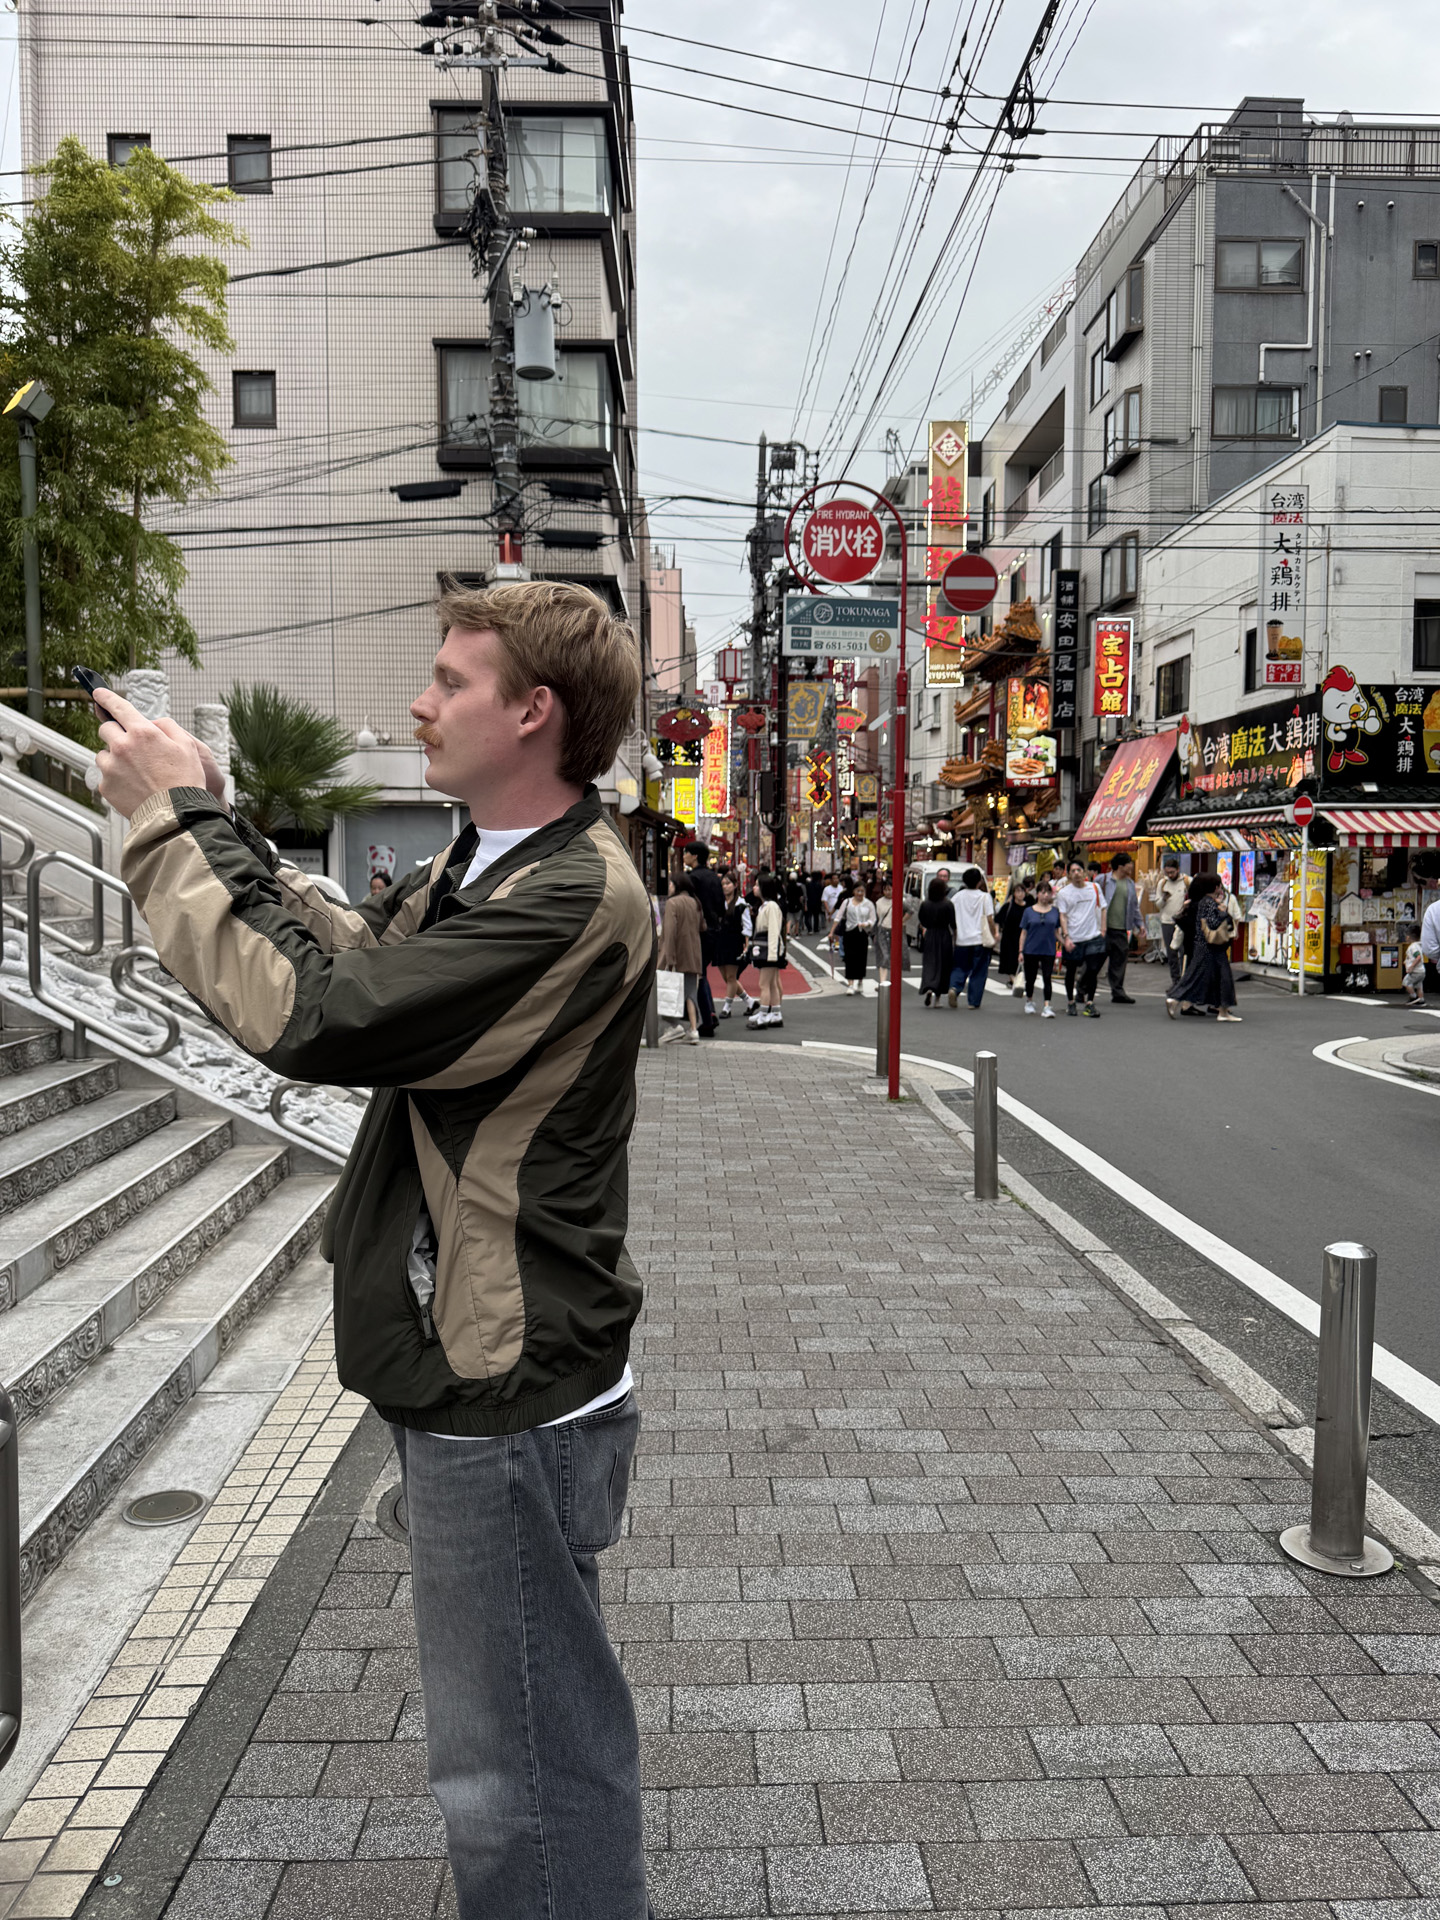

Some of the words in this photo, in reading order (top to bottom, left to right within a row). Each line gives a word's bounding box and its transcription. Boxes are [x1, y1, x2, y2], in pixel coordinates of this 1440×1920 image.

[1270, 492, 1305, 510] 台湾
[817, 510, 833, 519] FIRE
[836, 510, 870, 520] HYDRANT
[1271, 511, 1304, 524] 魔法
[810, 525, 878, 558] 消火栓
[1270, 532, 1294, 612] 大鶏排
[1293, 532, 1302, 612] タピオカミルクティー
[836, 606, 890, 617] TOKUNAGA
[826, 641, 867, 651] 681-5031
[1099, 633, 1125, 712] 宝占館
[1268, 664, 1300, 673] 食べ歩き
[1394, 687, 1424, 703] 台湾
[1393, 703, 1422, 717] 魔法
[1203, 712, 1320, 768] 台湾魔法大鶏排
[1396, 716, 1416, 773] 大鶏排
